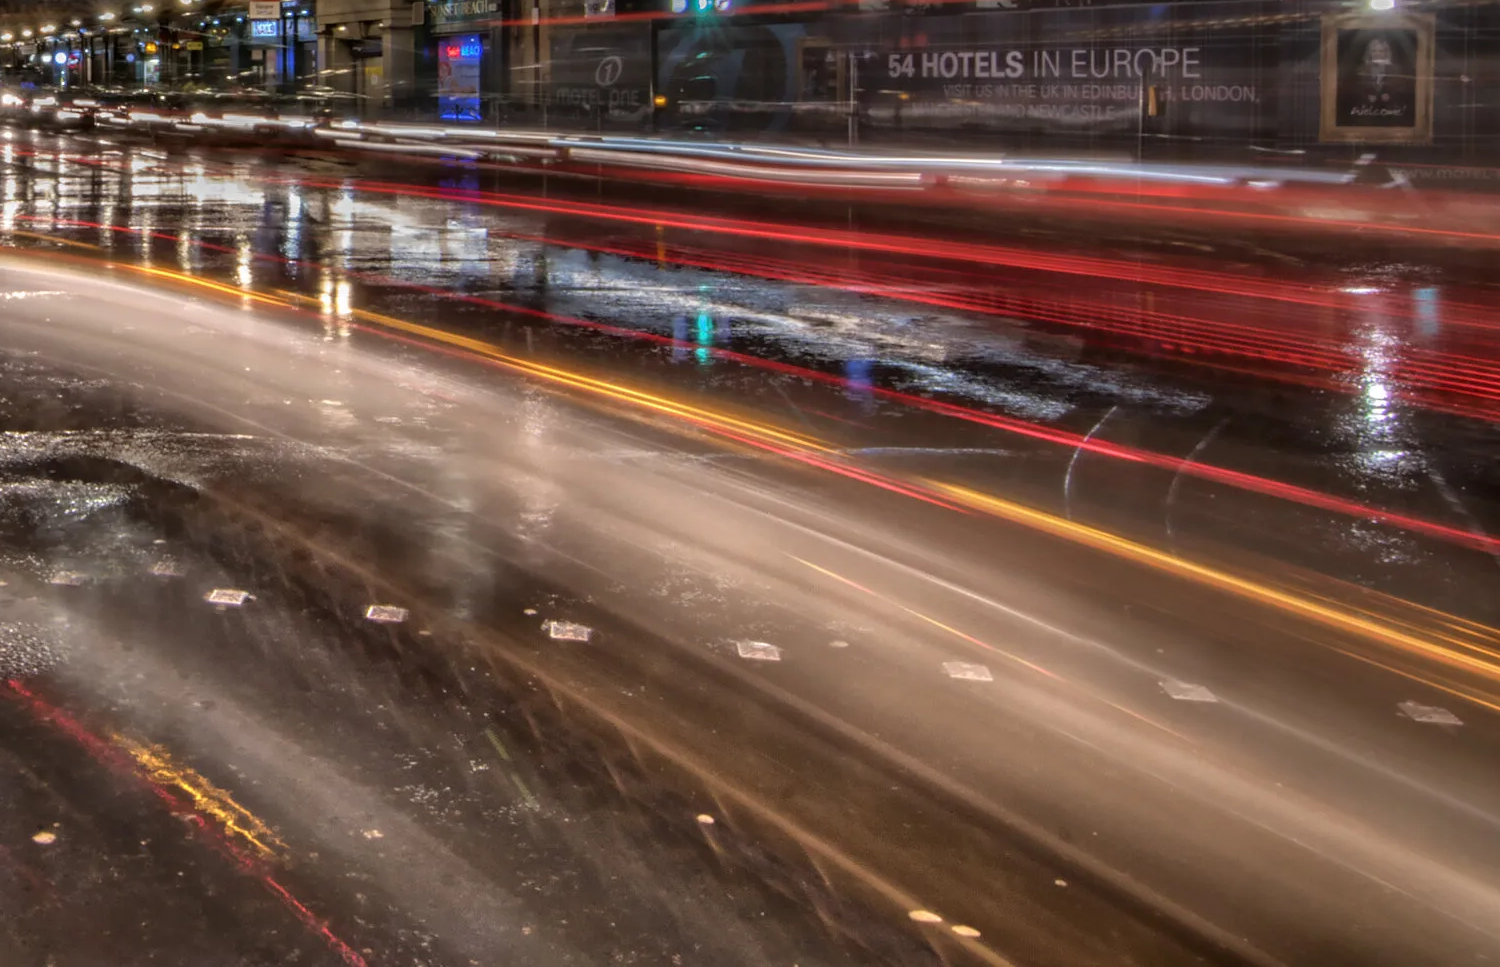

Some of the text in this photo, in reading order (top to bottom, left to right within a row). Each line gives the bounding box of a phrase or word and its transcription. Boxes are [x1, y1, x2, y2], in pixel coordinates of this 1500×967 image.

[888, 48, 1201, 78] 54 HOTELS IN EUROPE
[943, 84, 974, 98] VISIT
[975, 85, 994, 98] US
[1007, 85, 1037, 99] THE
[1040, 85, 1059, 99] UK
[1063, 85, 1078, 99] IN
[1181, 85, 1261, 102] LONDON,
[1027, 104, 1116, 120] NEWCASTLE
